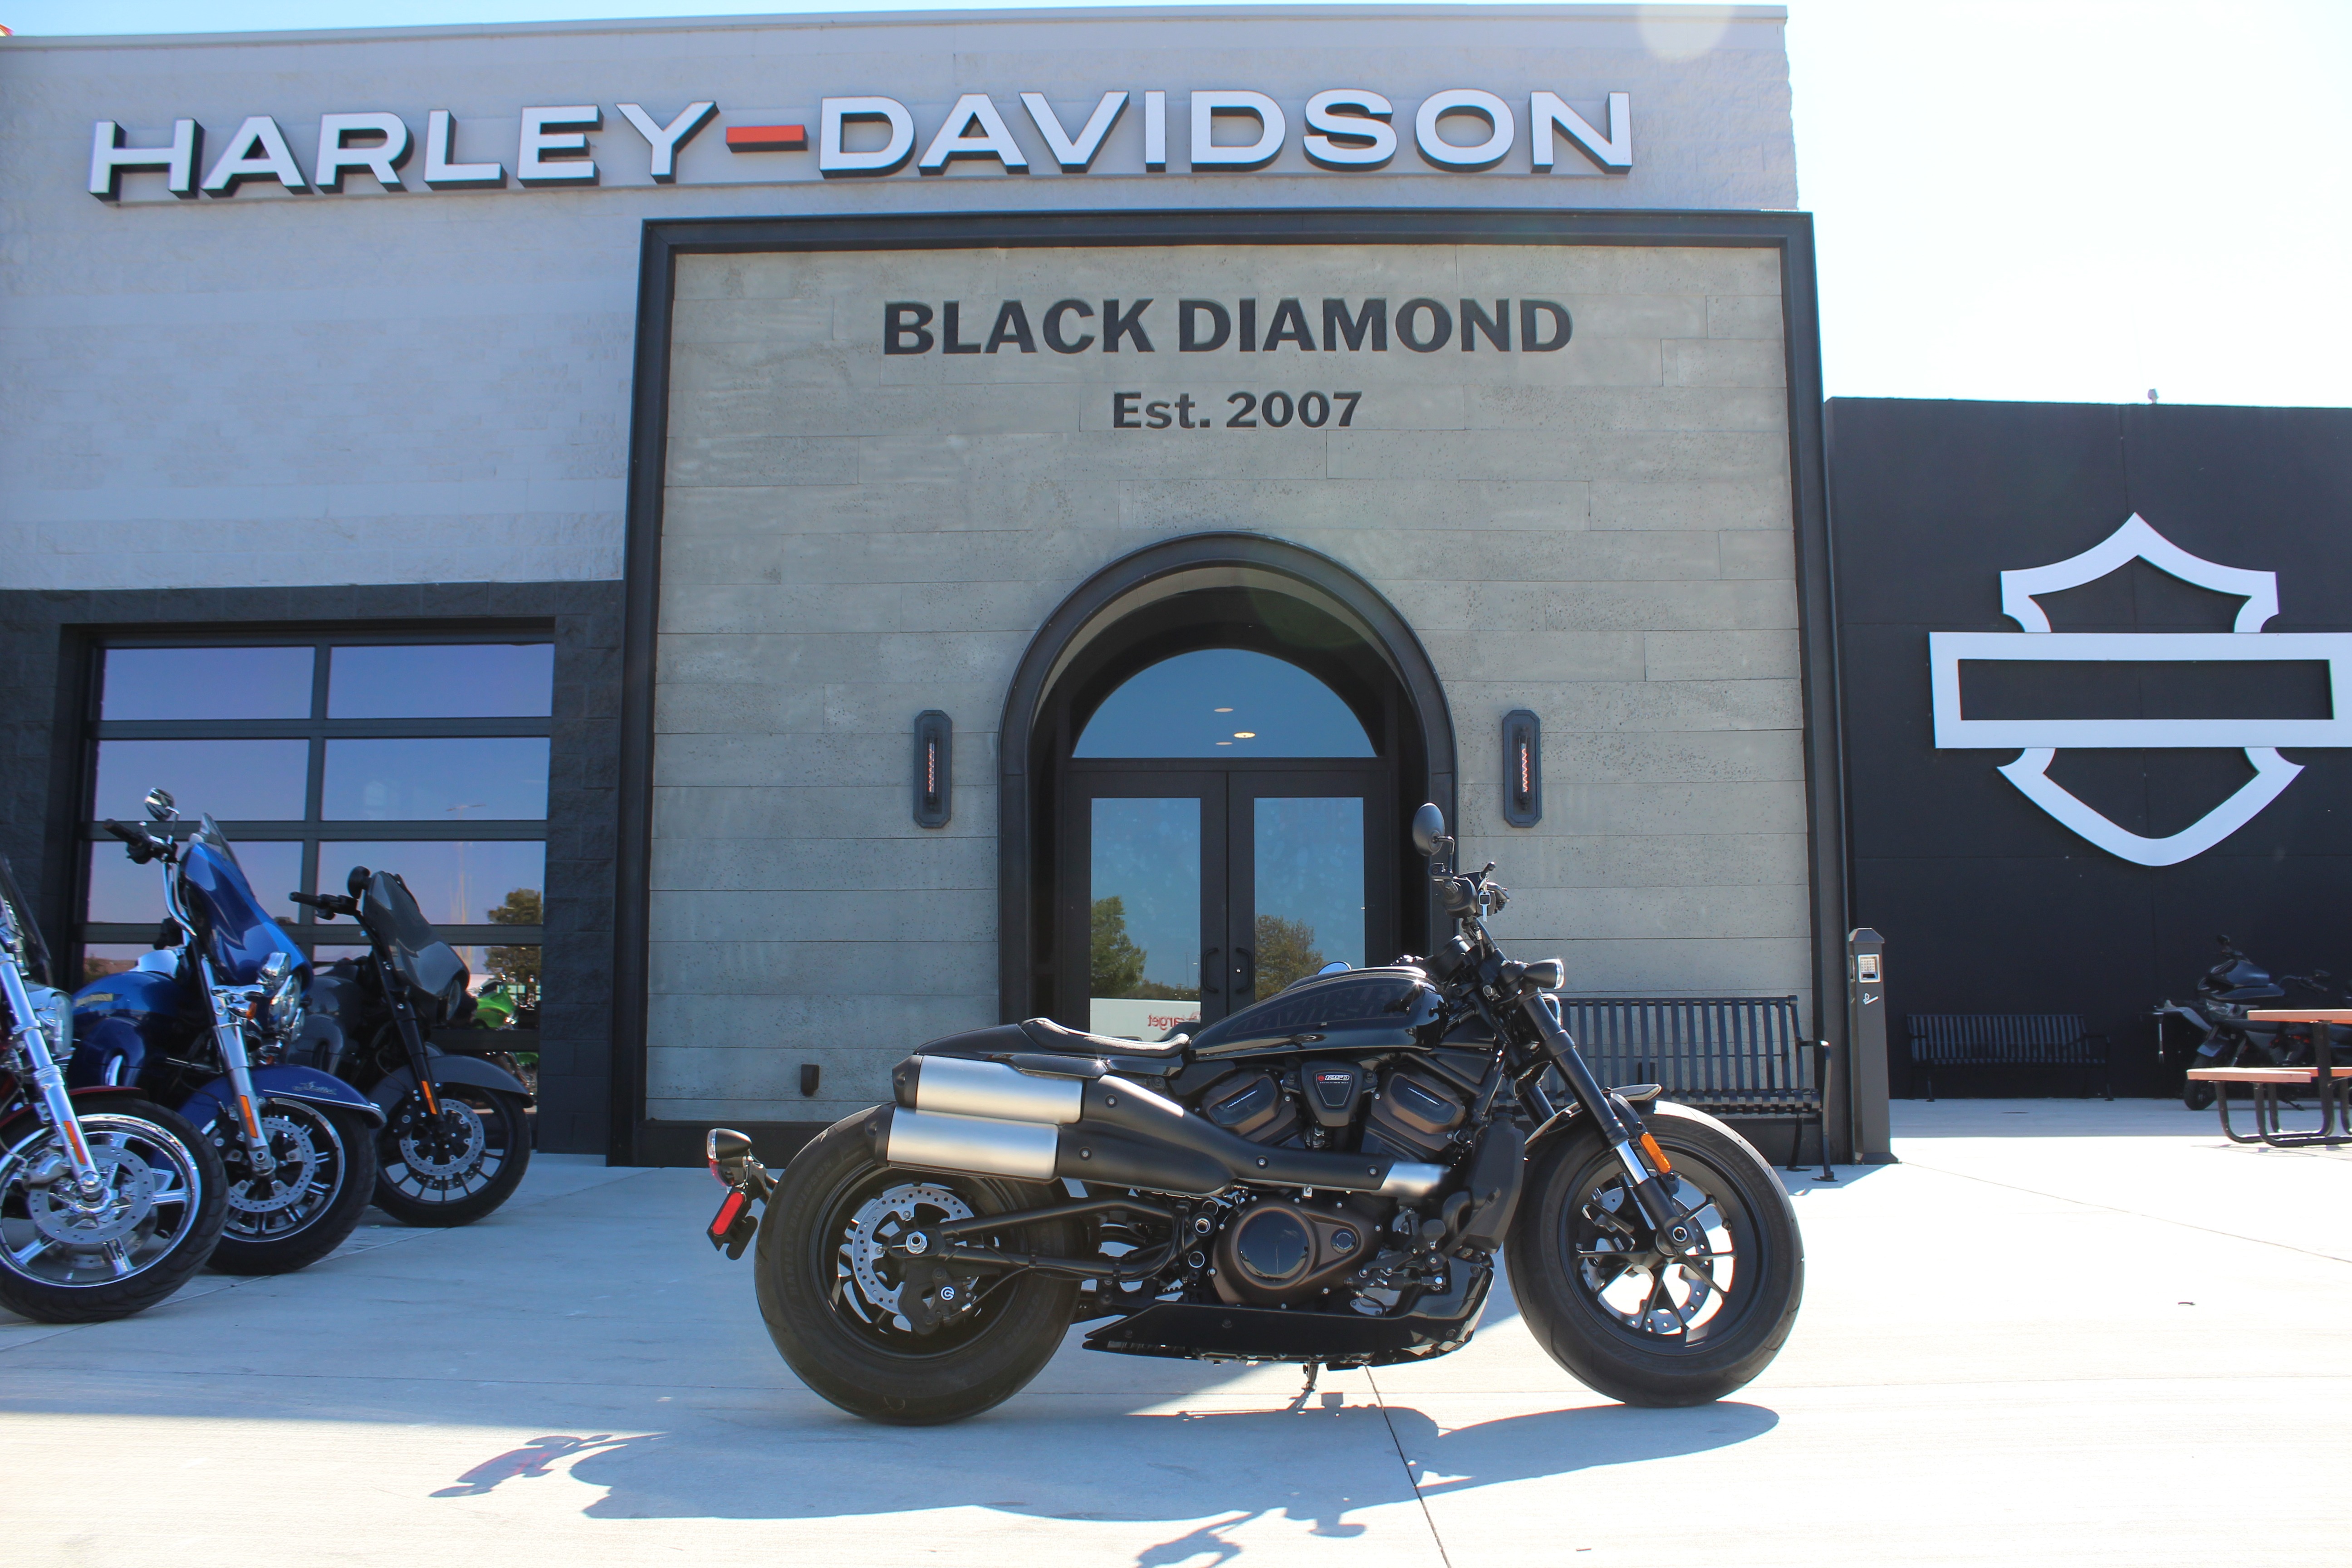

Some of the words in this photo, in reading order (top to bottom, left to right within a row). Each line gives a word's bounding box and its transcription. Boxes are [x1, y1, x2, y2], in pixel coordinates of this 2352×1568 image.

[89, 89, 1632, 200] HARLEY-DAVIDSON
[883, 297, 1154, 355] BLACK
[1179, 297, 1574, 353] DIAMOND
[1112, 391, 1210, 428] Est.
[1225, 391, 1362, 428] 2007
